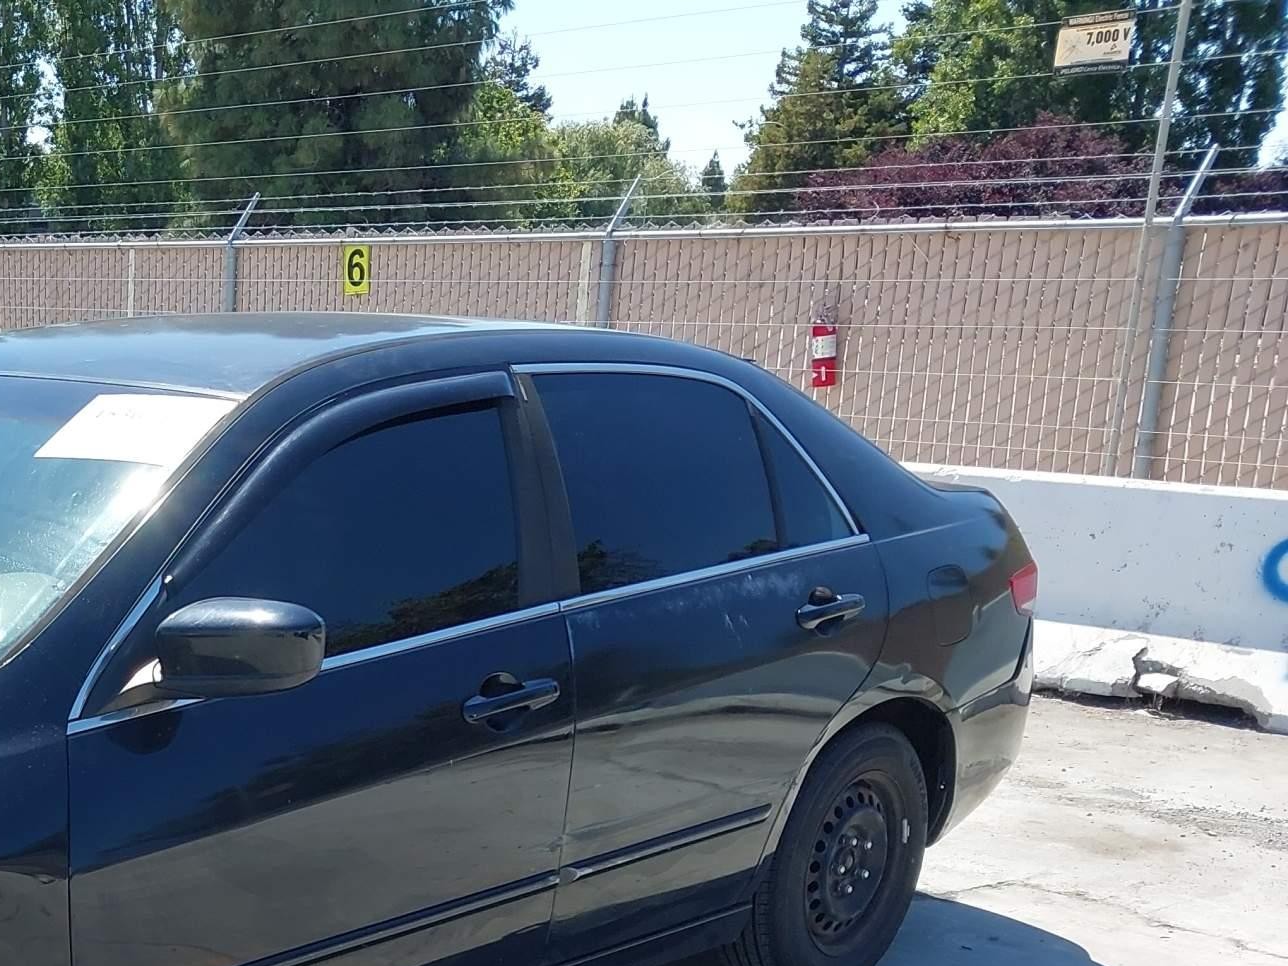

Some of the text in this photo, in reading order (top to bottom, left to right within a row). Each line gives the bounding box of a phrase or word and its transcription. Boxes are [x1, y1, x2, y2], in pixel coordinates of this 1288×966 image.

[1086, 29, 1120, 47] 7,000
[1123, 27, 1131, 41] V
[347, 248, 365, 287] 6
